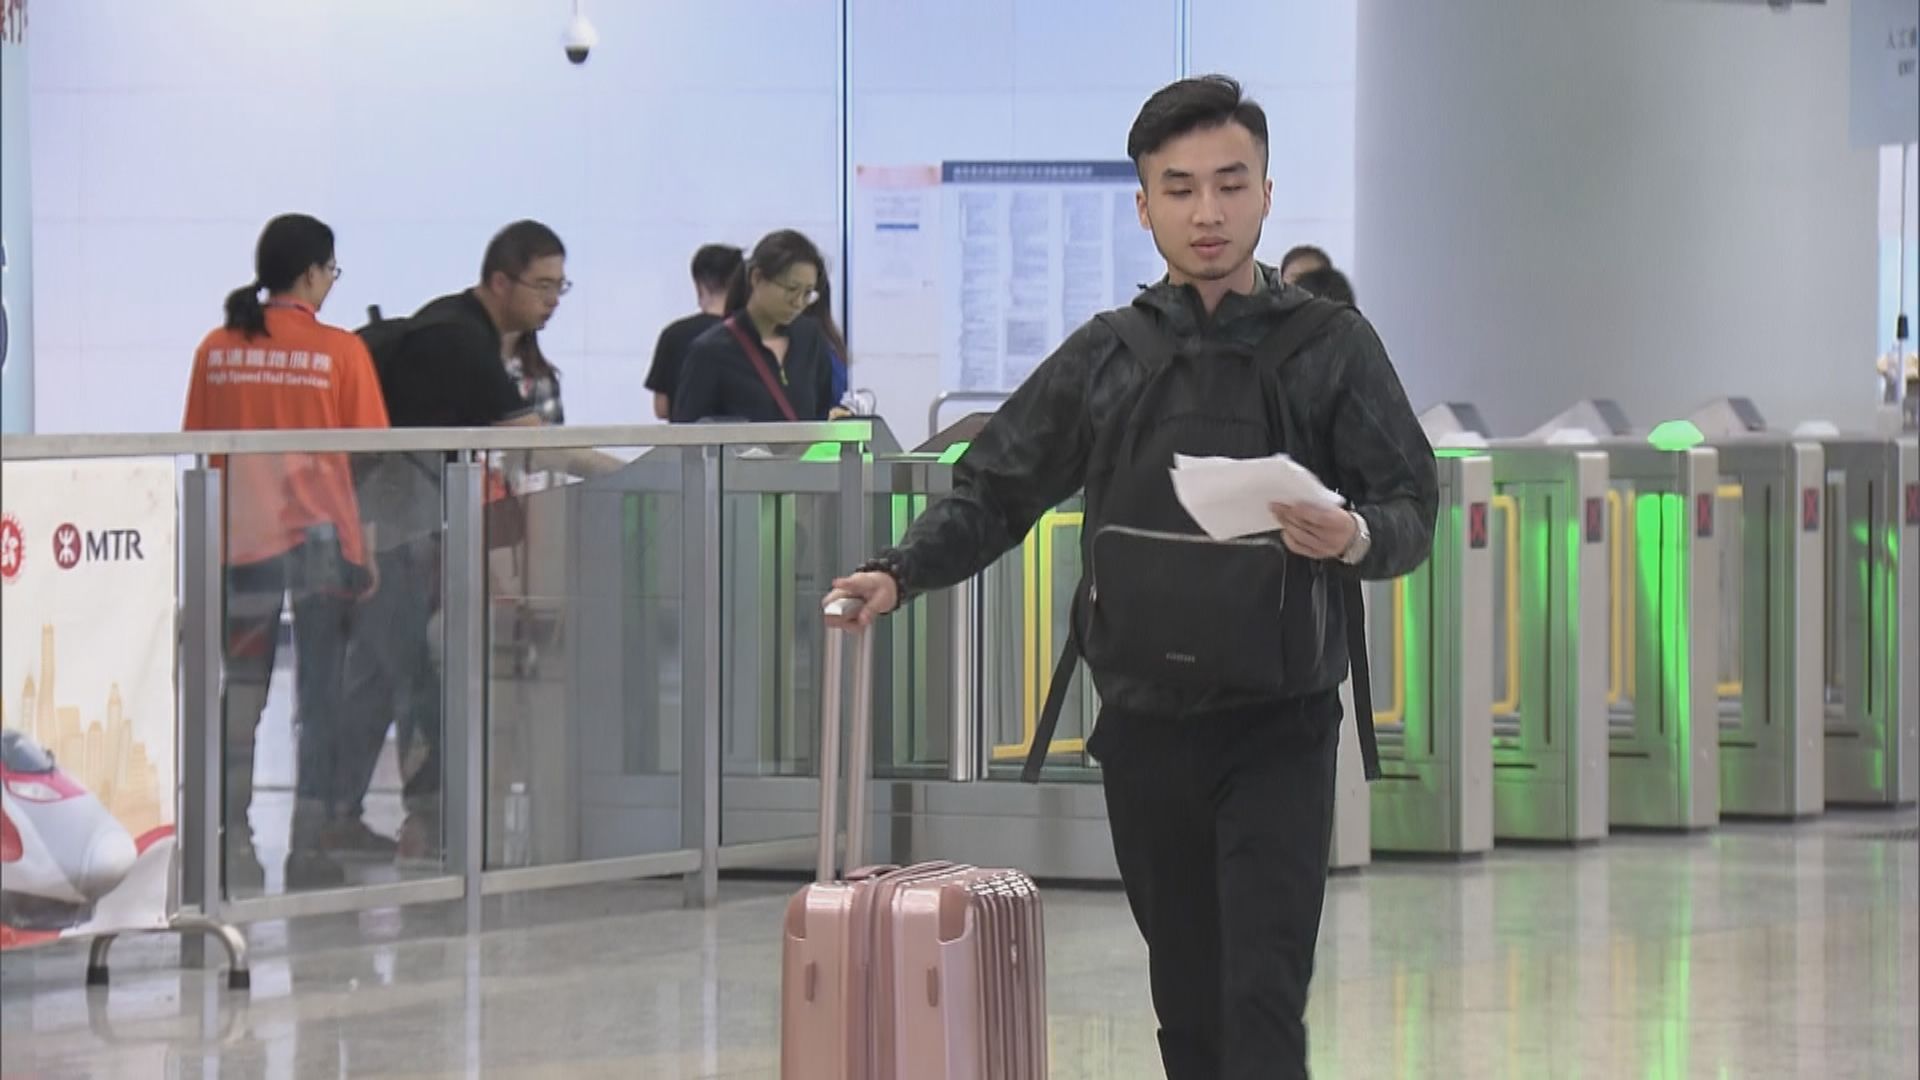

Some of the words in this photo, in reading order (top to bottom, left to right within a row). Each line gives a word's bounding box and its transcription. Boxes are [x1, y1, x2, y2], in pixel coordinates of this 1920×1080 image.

[229, 371, 261, 385] Speed
[285, 373, 330, 389] Services
[86, 530, 144, 561] MTR
